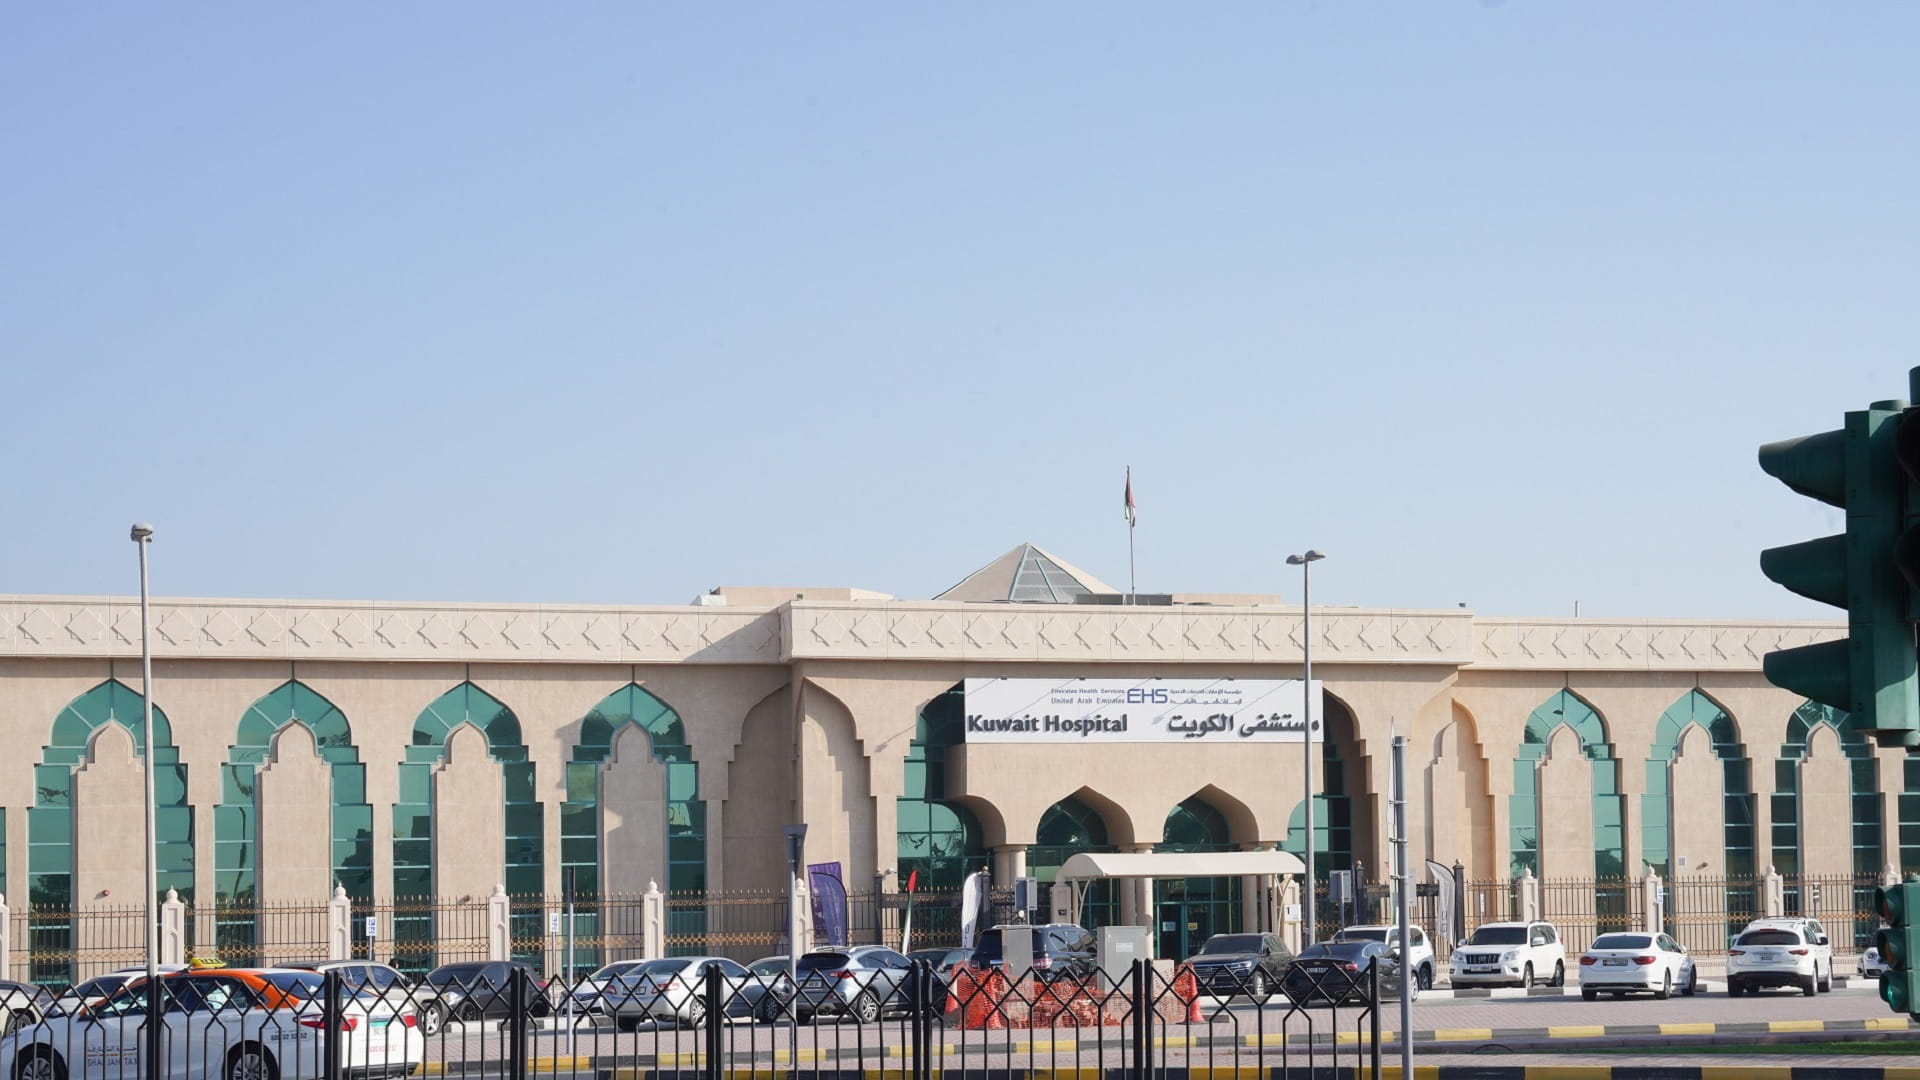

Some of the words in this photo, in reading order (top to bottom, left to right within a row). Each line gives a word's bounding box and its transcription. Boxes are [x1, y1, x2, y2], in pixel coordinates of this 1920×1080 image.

[1127, 688, 1168, 704] EHS
[968, 714, 1040, 732] Kuwait
[1044, 714, 1128, 737] Hospital
[1168, 713, 1234, 738] الكويت
[1240, 713, 1320, 737] مستشفى
